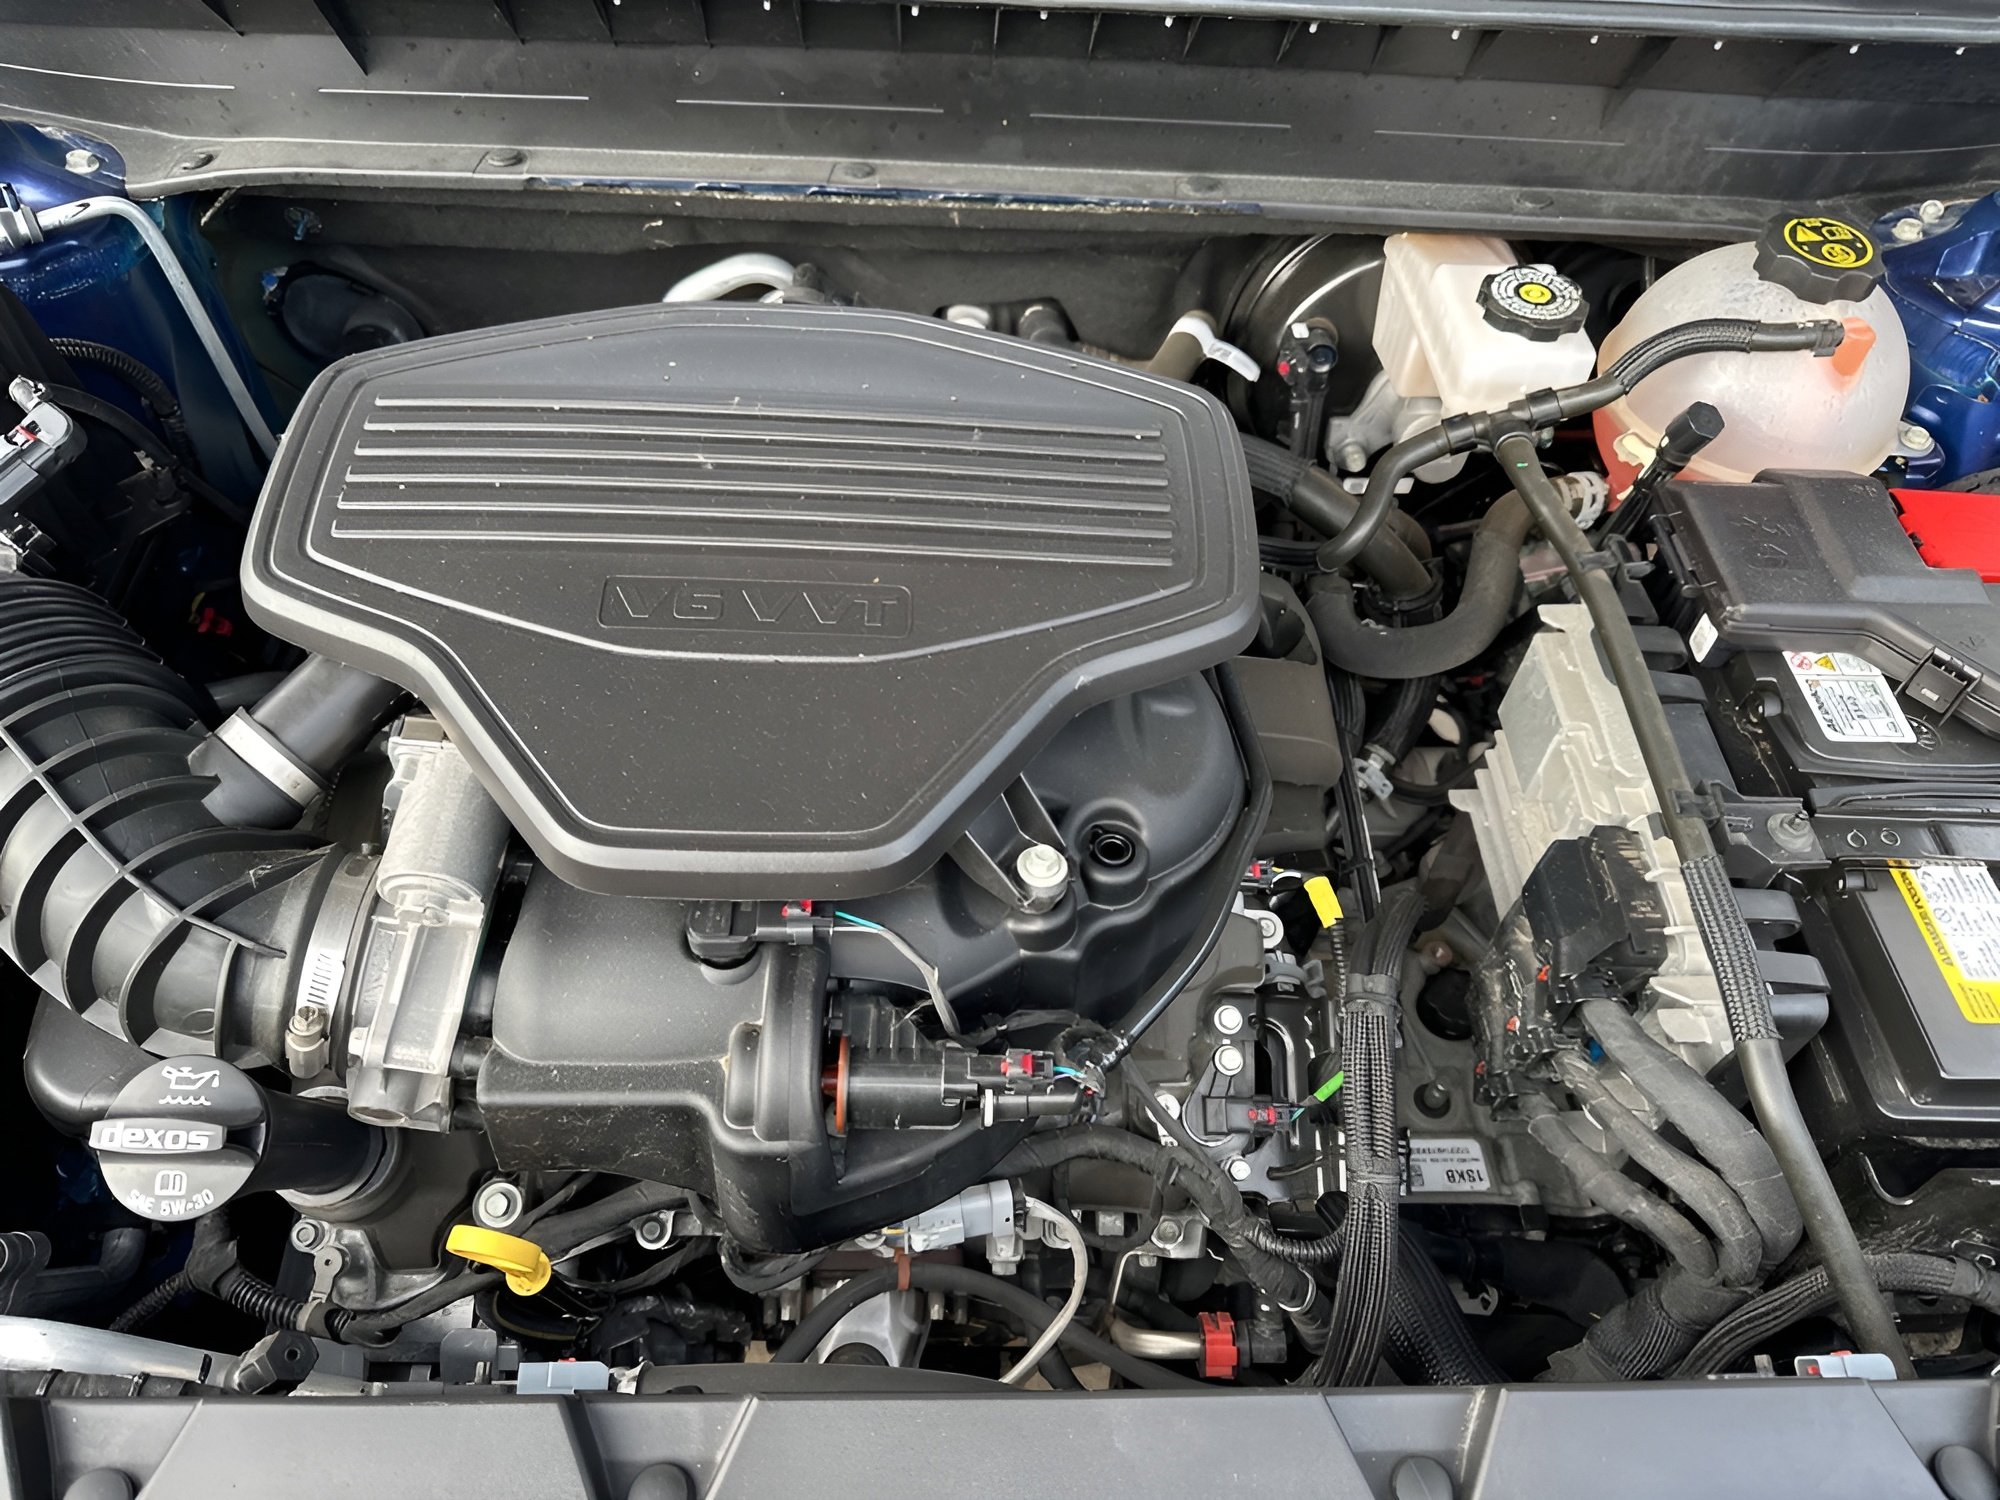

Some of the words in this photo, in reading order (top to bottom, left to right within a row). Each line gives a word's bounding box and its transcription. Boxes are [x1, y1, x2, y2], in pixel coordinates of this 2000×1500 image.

[615, 585, 724, 620] V6
[741, 588, 898, 627] VVT
[100, 1120, 216, 1150] dexos
[127, 1189, 156, 1214] SAE
